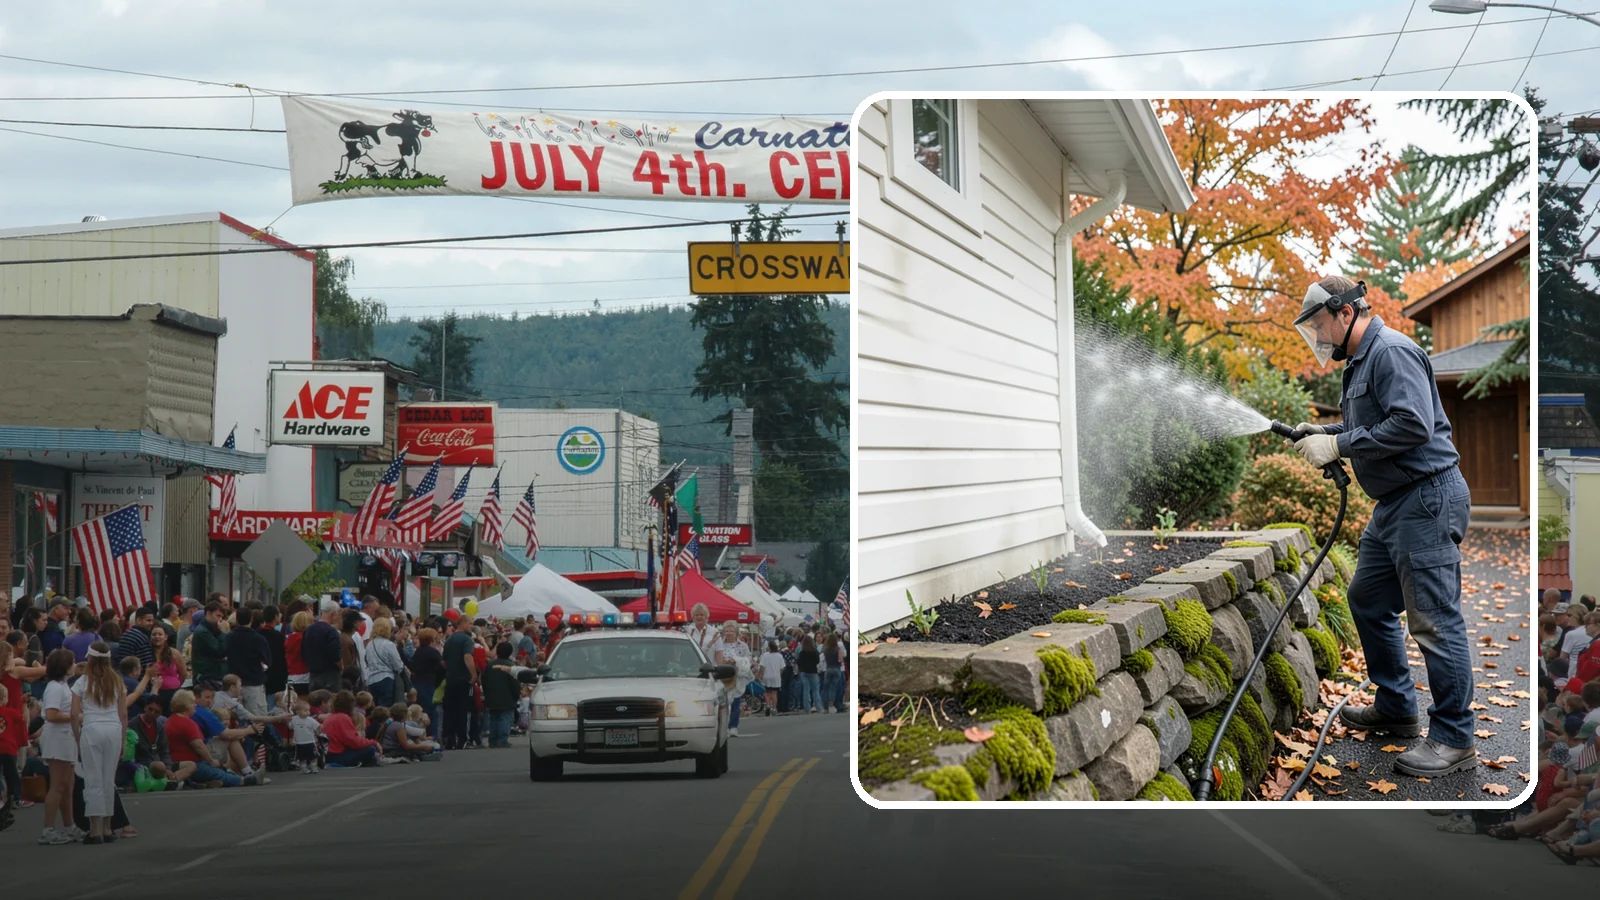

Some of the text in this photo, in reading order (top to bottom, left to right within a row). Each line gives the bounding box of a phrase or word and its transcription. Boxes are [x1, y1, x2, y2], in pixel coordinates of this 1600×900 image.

[695, 121, 850, 150] Carnat
[481, 141, 604, 192] JULY
[632, 150, 747, 197] 4th.
[697, 254, 850, 280] CROSSWA
[282, 380, 373, 420] ACE
[405, 409, 453, 422] CEDAR
[283, 421, 370, 436] Hardware
[416, 428, 477, 447] Coca-Cola
[83, 485, 155, 495] St. Vincent de Paul
[80, 504, 154, 521] THT
[688, 526, 741, 535] CRNATION
[699, 535, 730, 543] GLASS
